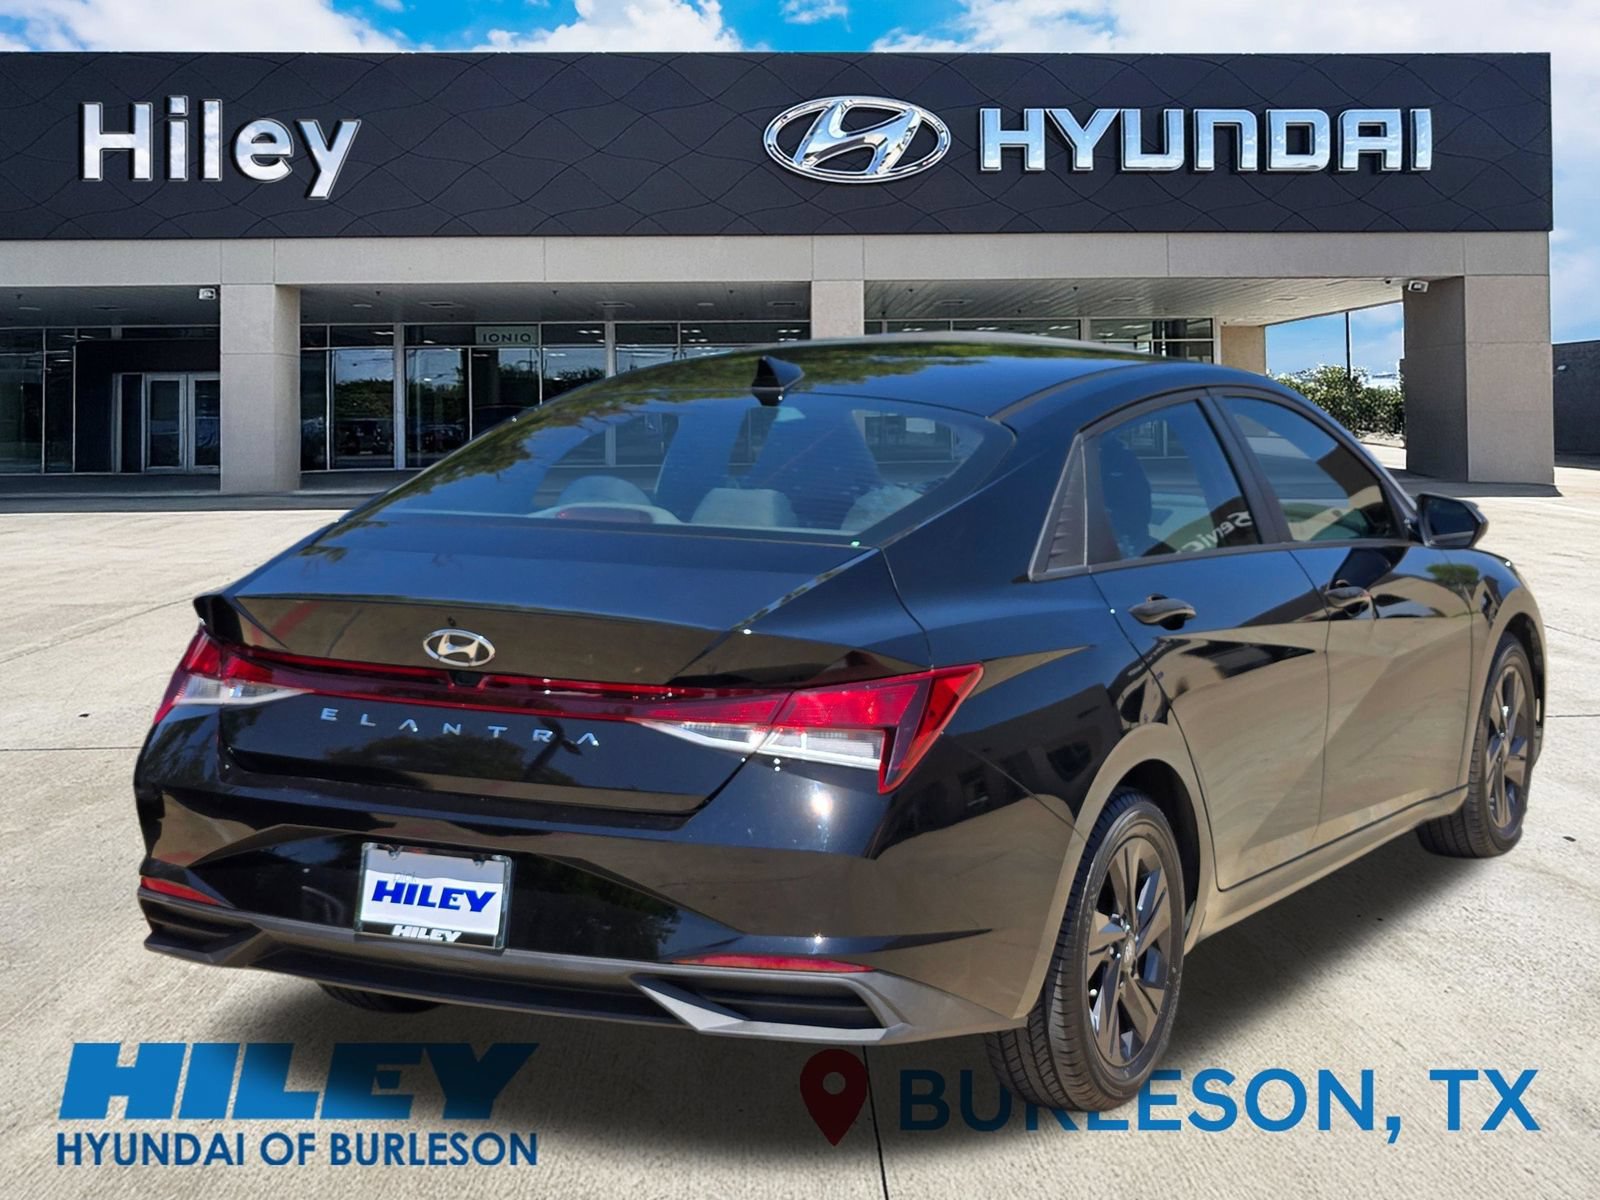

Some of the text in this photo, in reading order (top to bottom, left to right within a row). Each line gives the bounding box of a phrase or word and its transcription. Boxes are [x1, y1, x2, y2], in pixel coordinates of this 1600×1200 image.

[80, 95, 362, 199] Hiley
[979, 107, 1434, 173] HYUNDAI
[320, 707, 600, 747] ELANTRA
[371, 880, 497, 913] HILEY
[391, 924, 462, 943] HILEY
